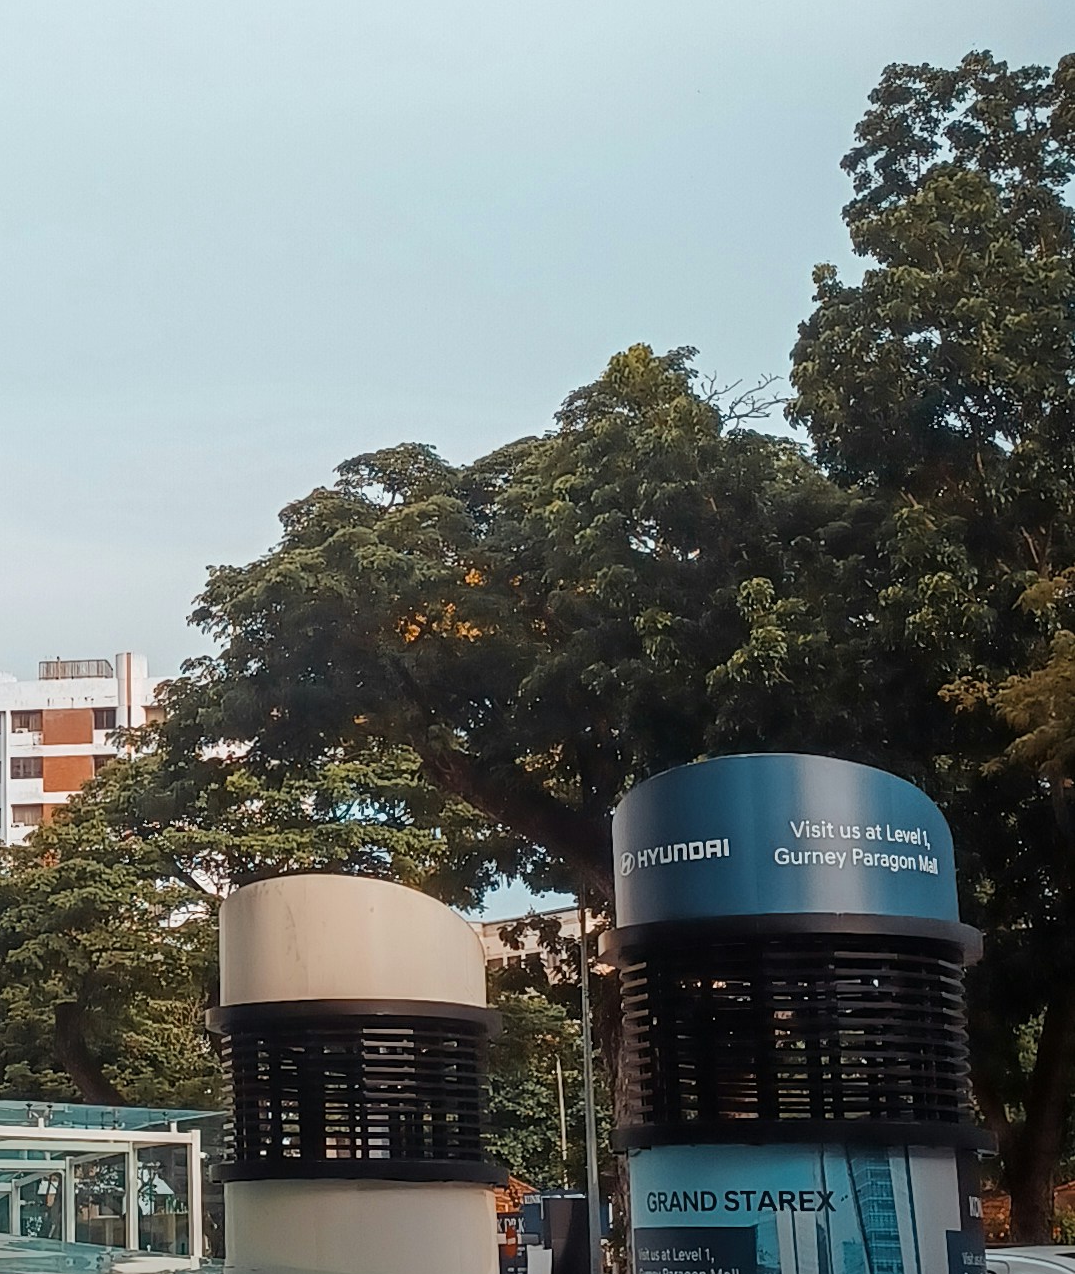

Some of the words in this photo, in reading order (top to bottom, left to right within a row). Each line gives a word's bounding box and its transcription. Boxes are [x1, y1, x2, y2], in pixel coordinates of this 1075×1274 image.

[789, 820, 834, 839] Visit
[839, 825, 861, 840] us
[865, 824, 883, 841] at
[886, 824, 921, 846] Level
[637, 838, 730, 869] HYUNDAI
[773, 847, 847, 869] Gurney
[852, 848, 917, 872] Paragon
[918, 854, 939, 875] Mall
[646, 1191, 718, 1213] GRAND
[724, 1190, 837, 1212] STAREX
[650, 1249, 661, 1262] us
[661, 1248, 672, 1262] at
[672, 1247, 702, 1262] Level
[704, 1248, 715, 1265] 1,
